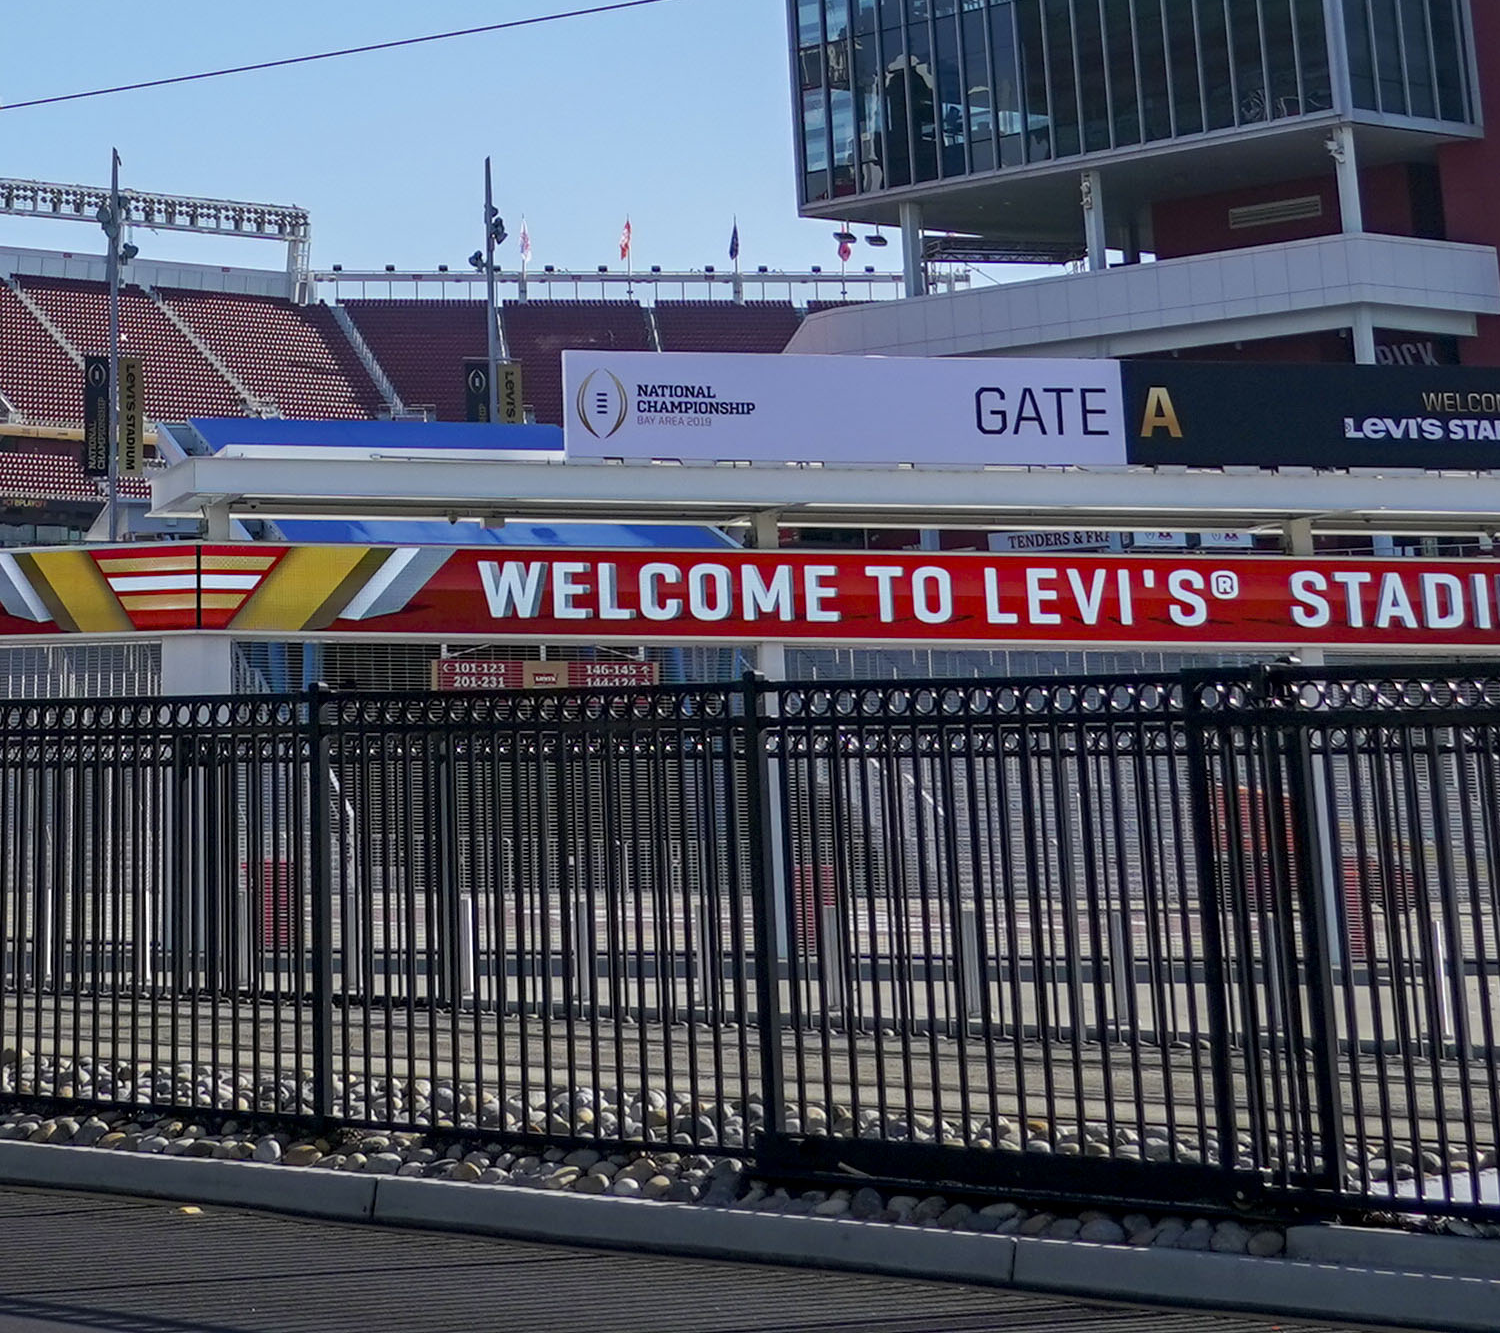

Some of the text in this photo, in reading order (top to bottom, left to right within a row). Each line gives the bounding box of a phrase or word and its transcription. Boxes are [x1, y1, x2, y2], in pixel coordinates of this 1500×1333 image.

[637, 384, 716, 399] NATIONAL
[637, 400, 756, 415] CHAMPIONSHIP
[974, 386, 1184, 437] GATE A
[637, 416, 712, 426] BAY AREA 2019
[88, 421, 97, 470] NATIONAL
[126, 414, 136, 470] STADIUM
[1008, 531, 1074, 549] TENDERS
[1074, 532, 1083, 545] &
[477, 560, 843, 622] WELCOME
[865, 565, 953, 625] TO
[454, 663, 637, 674] 101-123 146-145
[453, 676, 505, 687] 201-231
